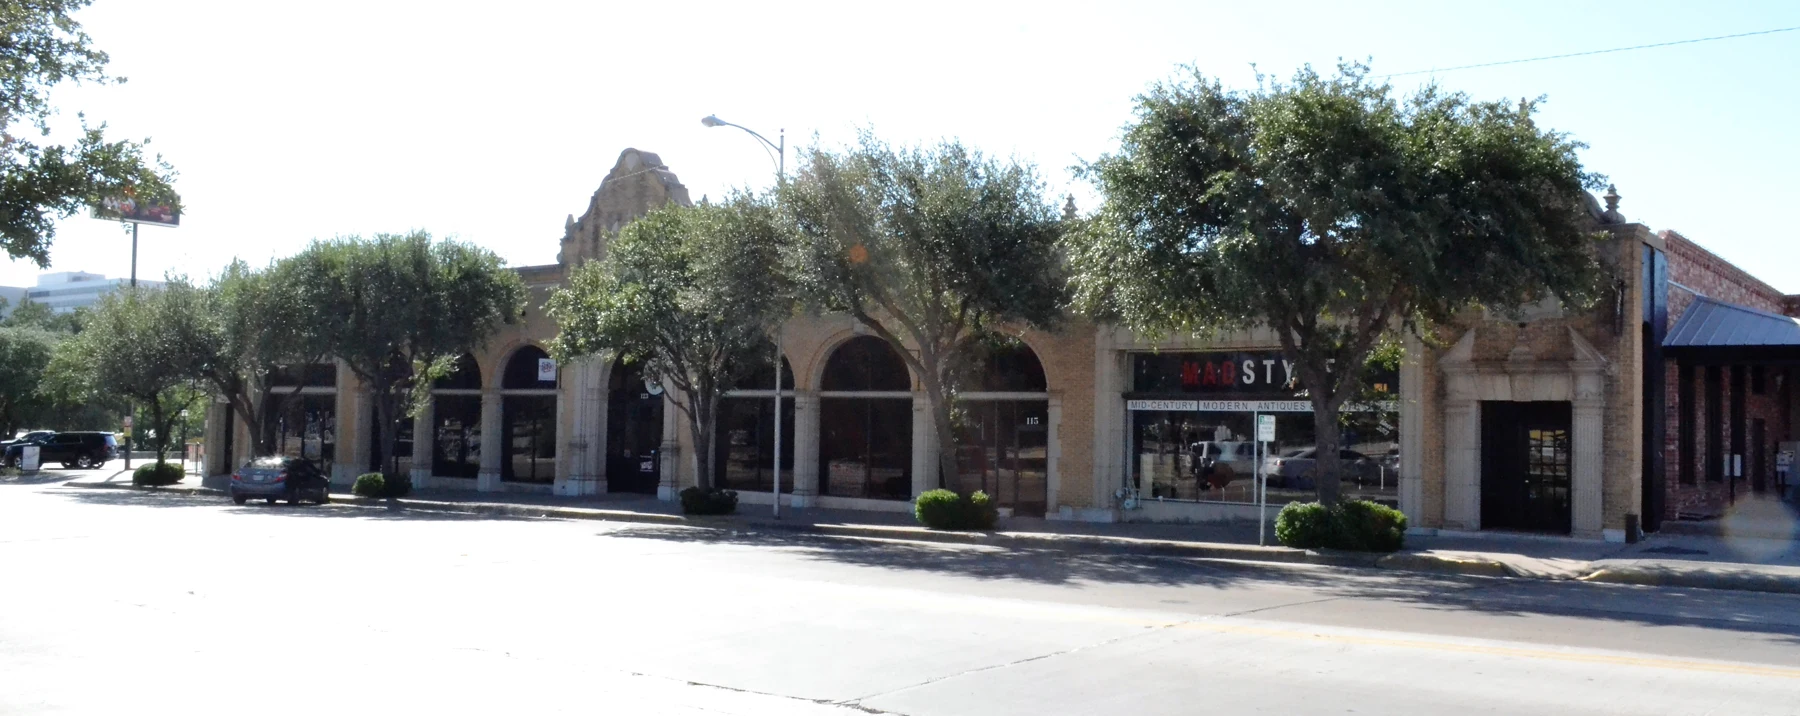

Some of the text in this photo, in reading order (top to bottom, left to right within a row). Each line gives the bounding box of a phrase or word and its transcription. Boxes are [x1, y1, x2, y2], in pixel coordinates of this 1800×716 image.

[1131, 401, 1194, 410] MID-CENTURY
[1257, 402, 1306, 411] ANTIQUES
[1026, 417, 1039, 425] 115
